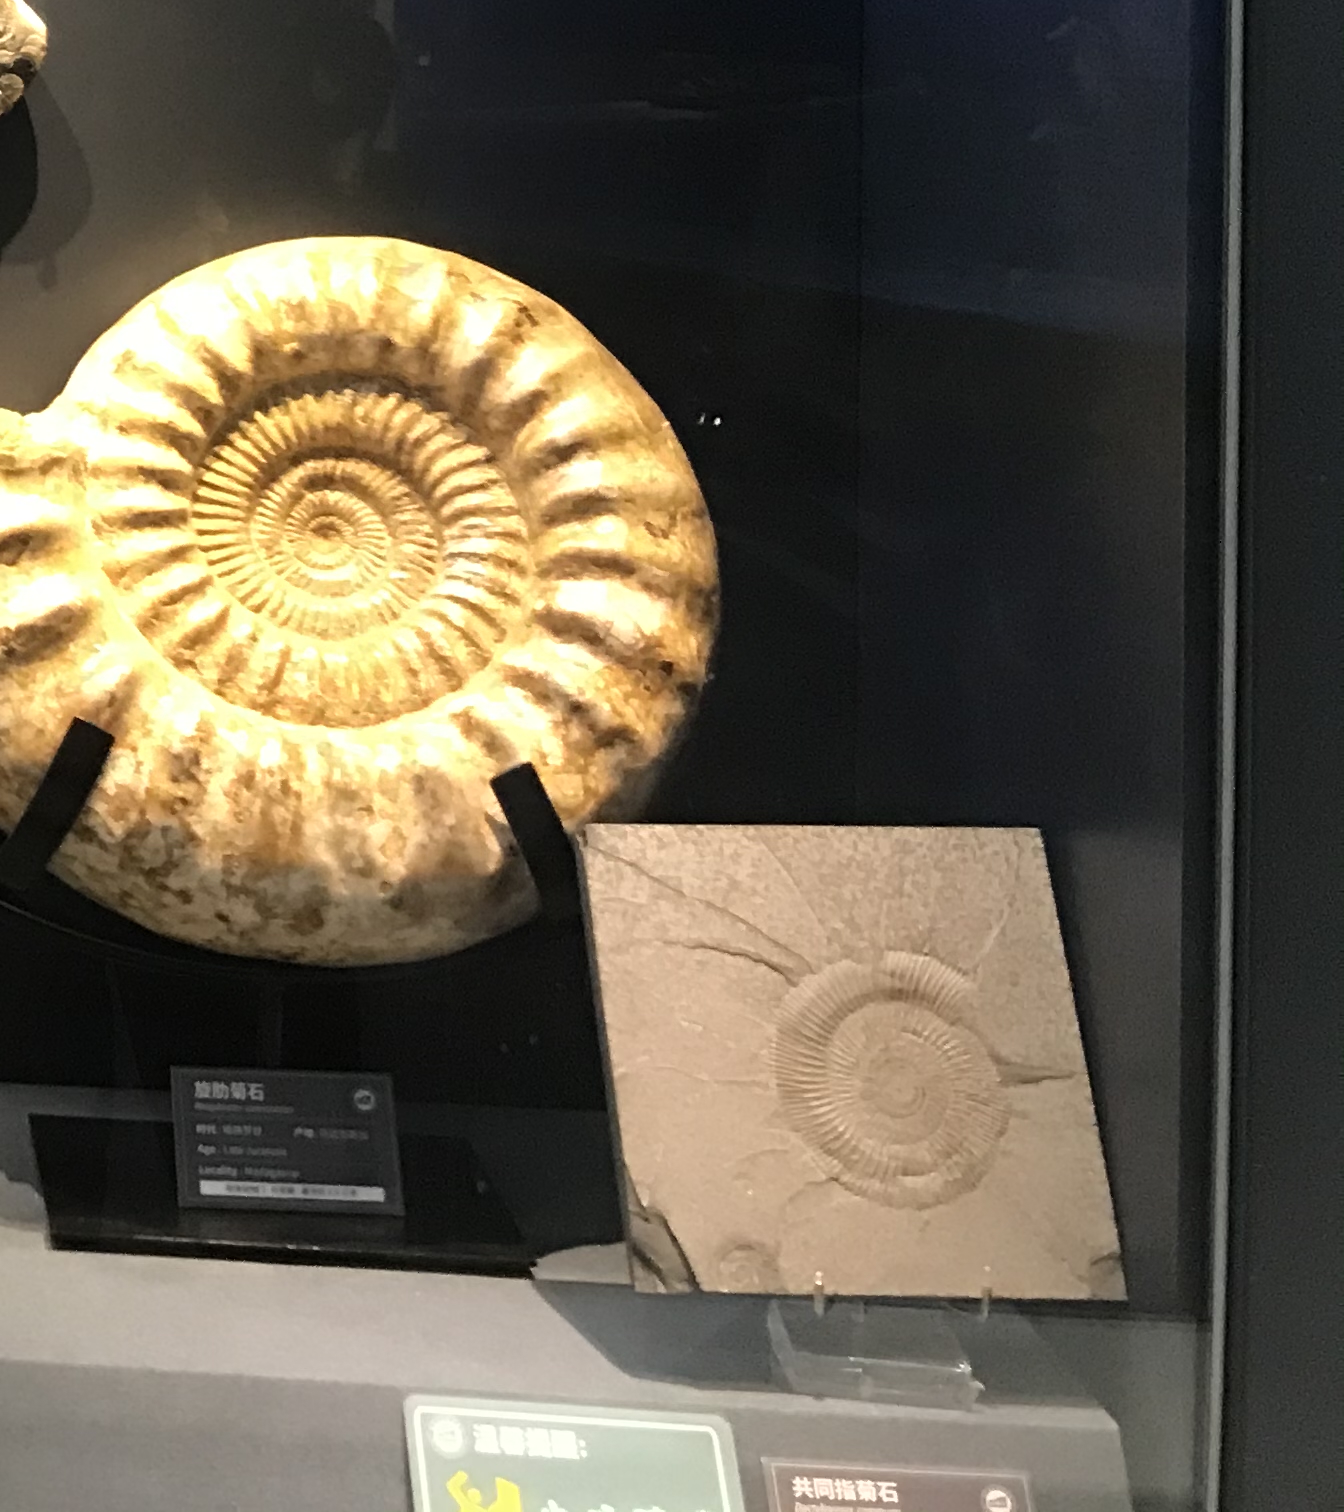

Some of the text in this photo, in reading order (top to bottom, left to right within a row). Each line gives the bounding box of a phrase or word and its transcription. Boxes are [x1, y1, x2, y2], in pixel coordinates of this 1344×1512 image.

[792, 1476, 899, 1502] 共同指菊石
